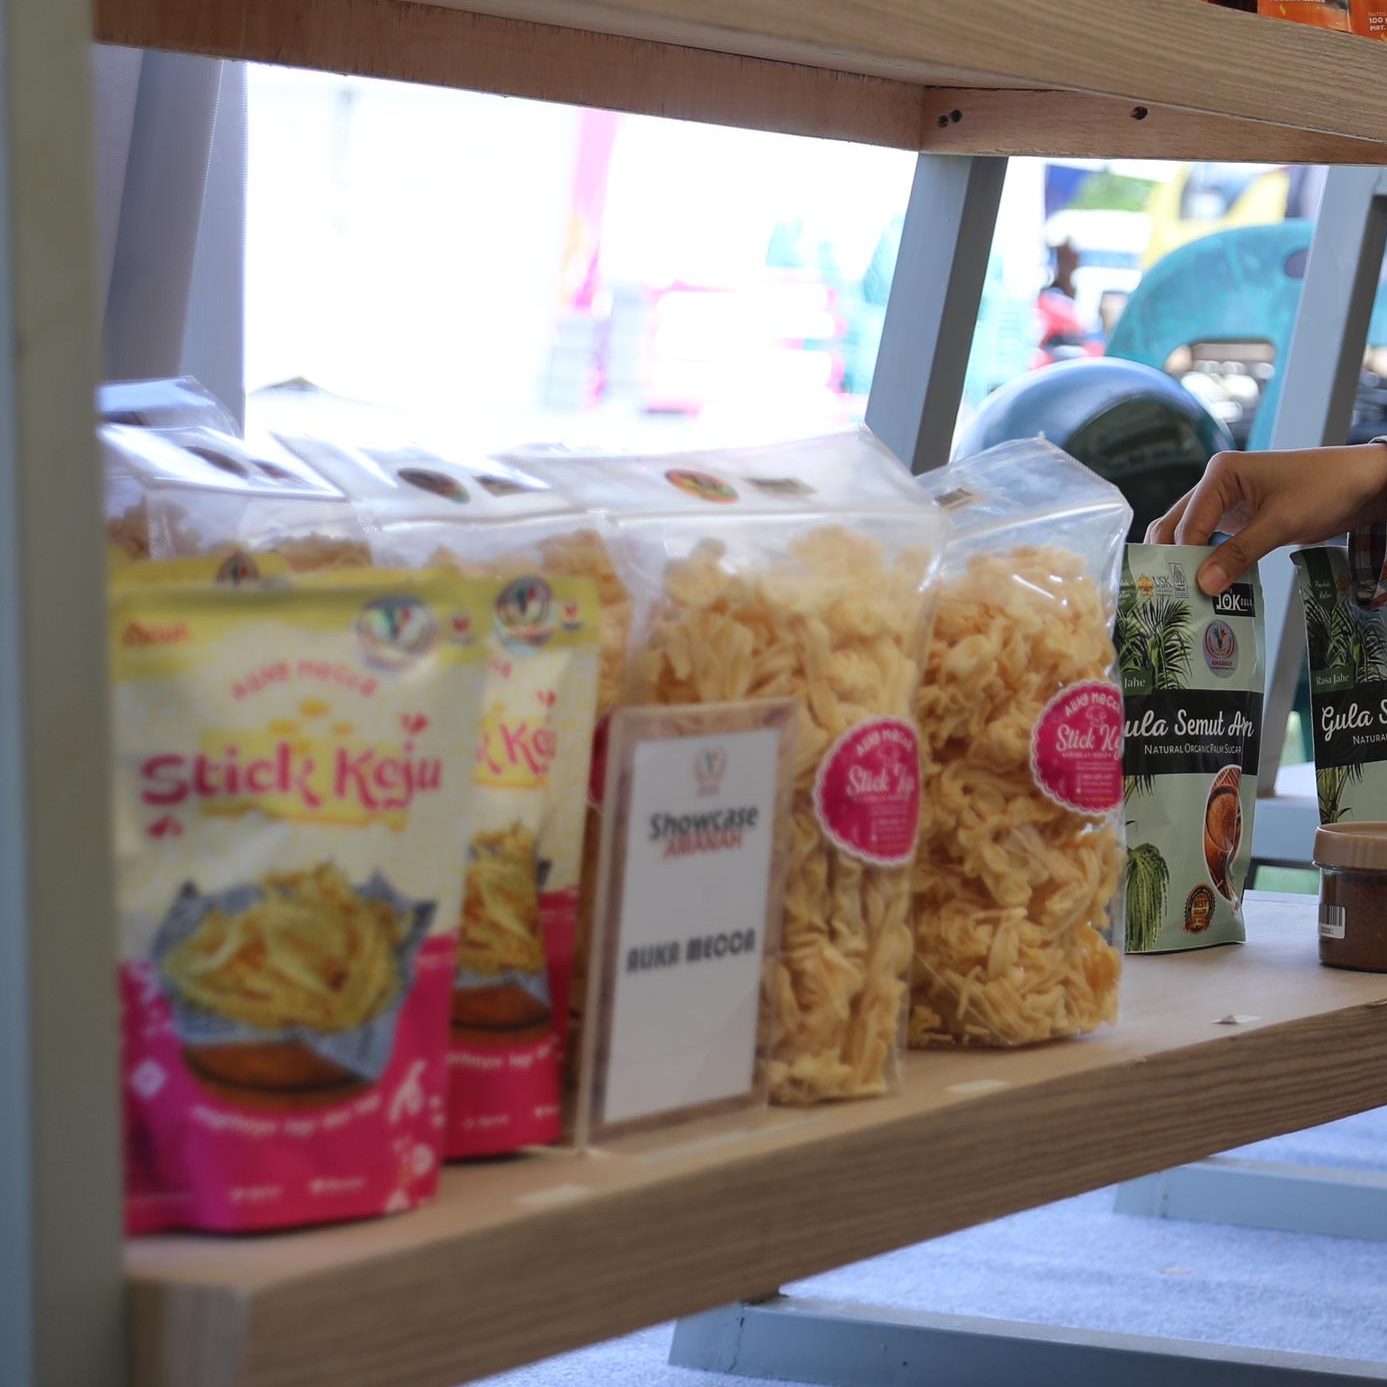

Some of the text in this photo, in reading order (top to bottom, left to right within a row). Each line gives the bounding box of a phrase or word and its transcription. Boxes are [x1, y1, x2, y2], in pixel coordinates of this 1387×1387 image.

[1152, 575, 1172, 588] USK
[1124, 677, 1146, 689] Jahe
[1316, 673, 1350, 686] Rasa Jahe
[1124, 710, 1169, 738] ula
[1174, 709, 1226, 736] Semut
[1321, 703, 1374, 741] Gula
[1055, 724, 1095, 752] Stick
[1144, 743, 1242, 755] NATURAL ORGANIC PALM SUGAR
[140, 740, 322, 809] Stick
[333, 740, 442, 811] Keju
[649, 807, 758, 840] Showcase
[663, 829, 743, 859] AMANAH
